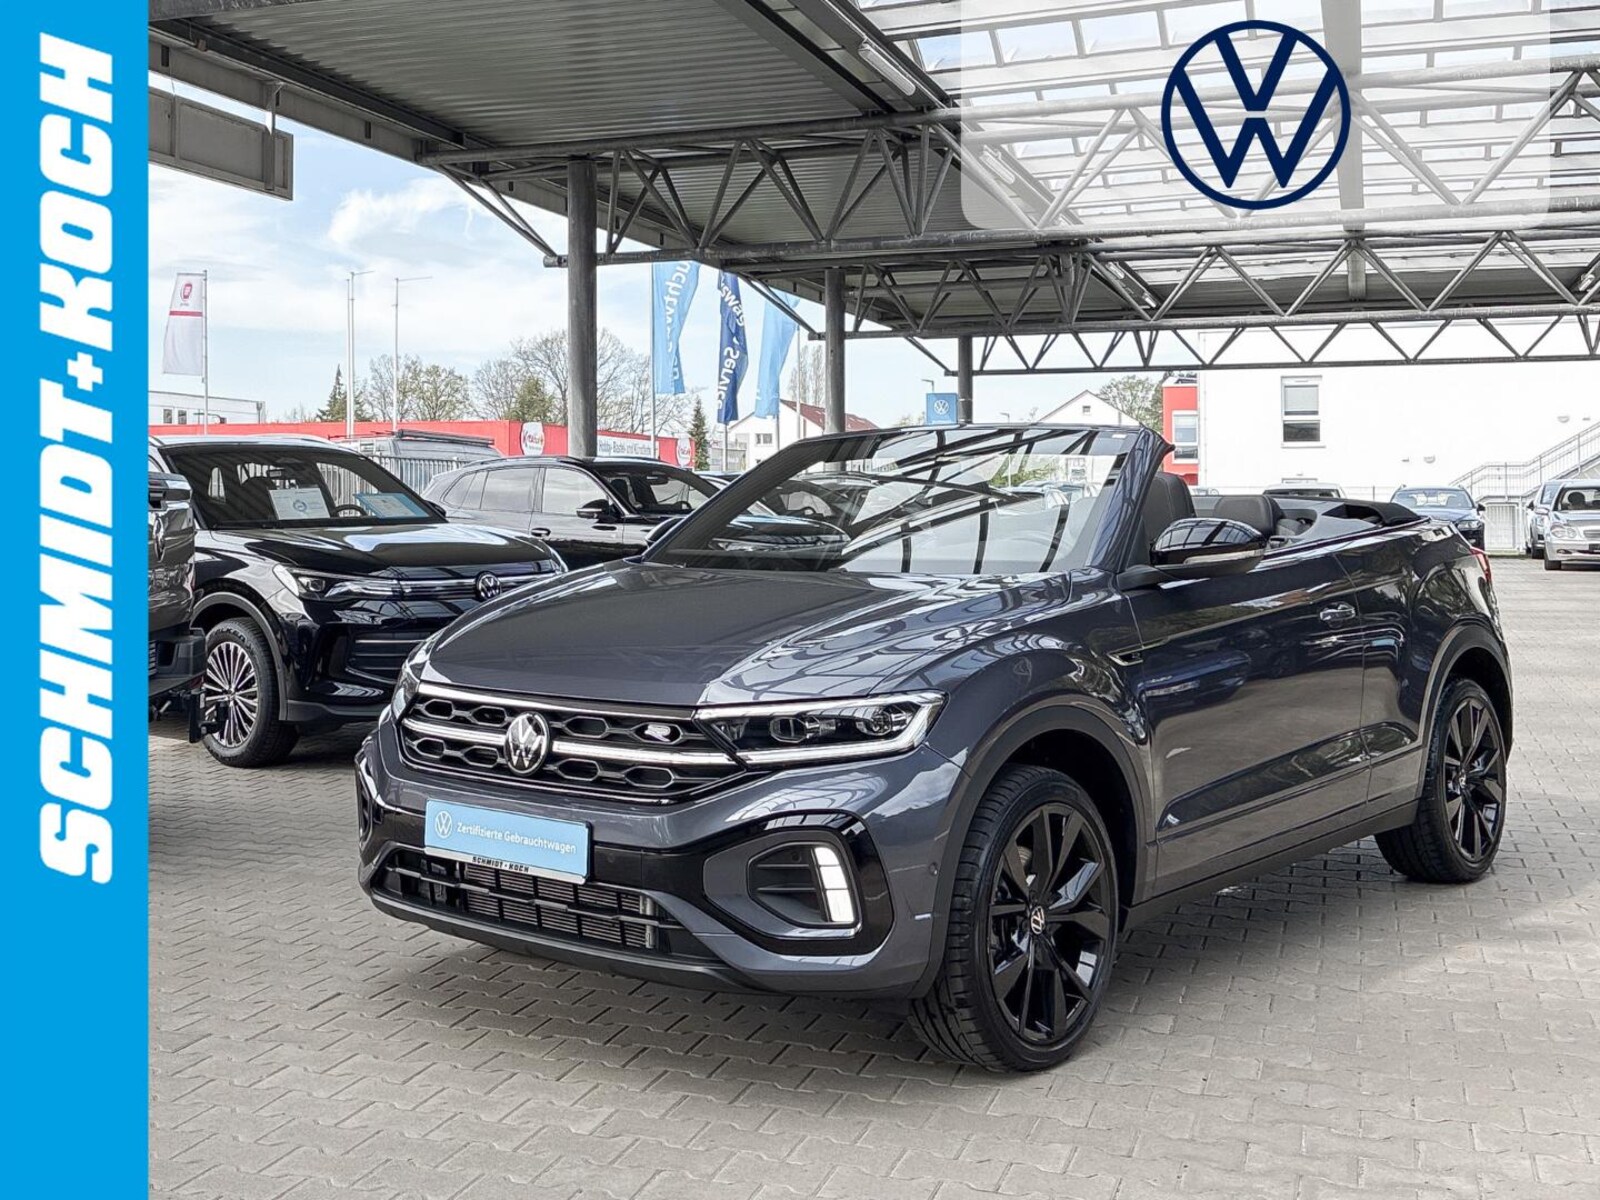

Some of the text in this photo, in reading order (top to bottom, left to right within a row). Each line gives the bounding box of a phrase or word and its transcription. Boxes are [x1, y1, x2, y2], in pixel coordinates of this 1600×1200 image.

[456, 822, 503, 841] Zertifizierte
[504, 830, 577, 854] Gebrauchtwagen
[472, 856, 503, 868] SCHMIDT
[509, 864, 530, 873] KOCH
